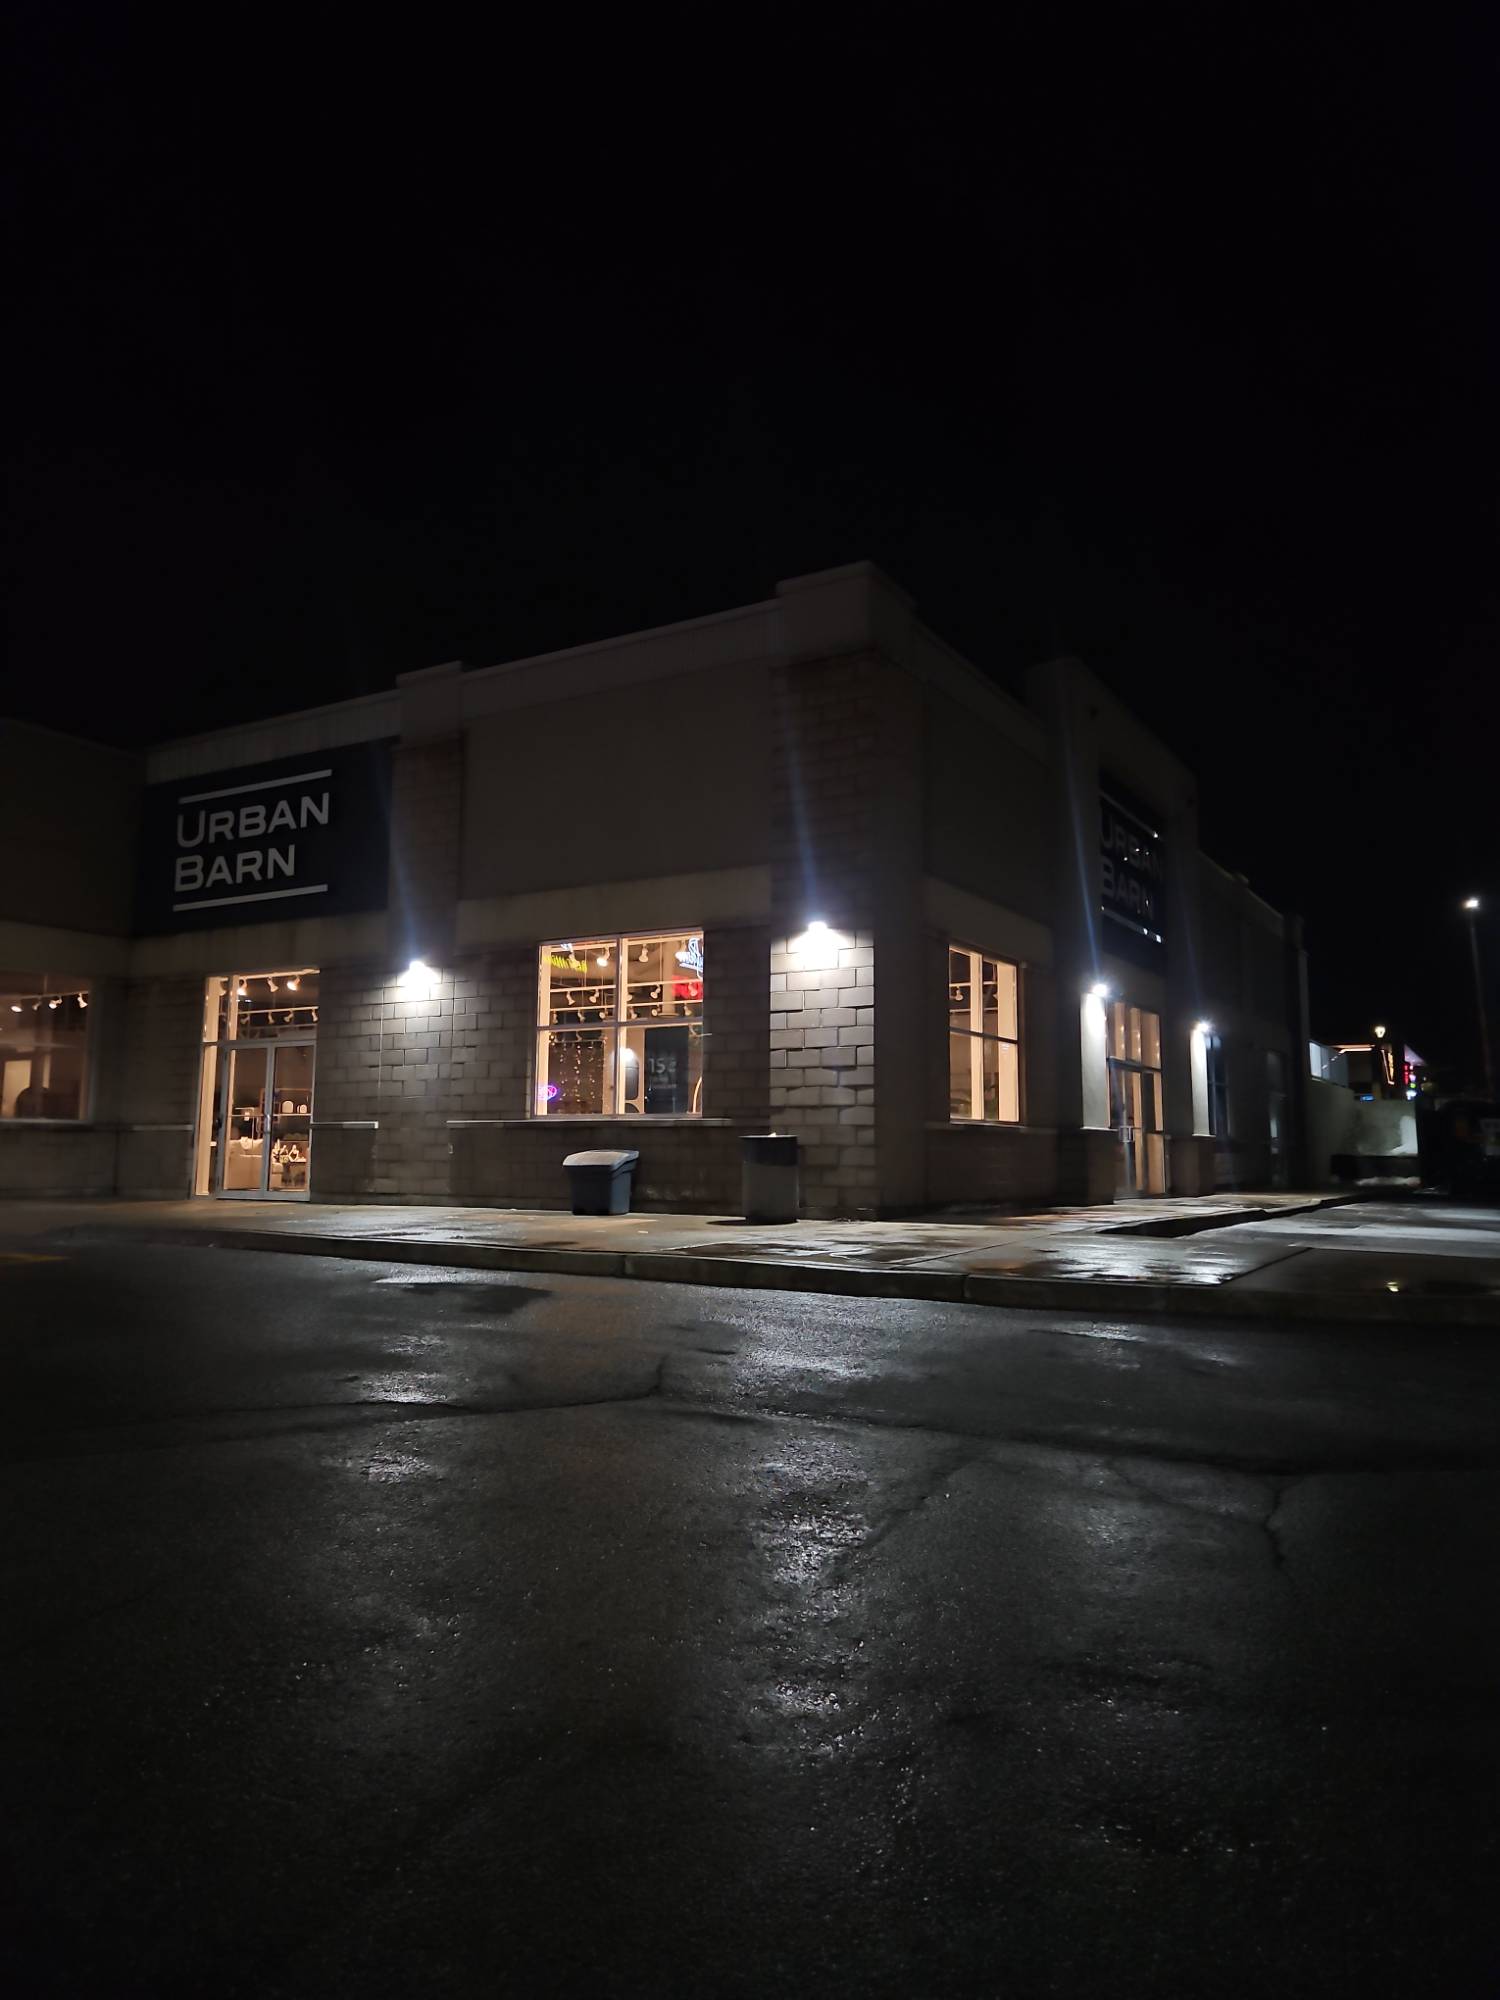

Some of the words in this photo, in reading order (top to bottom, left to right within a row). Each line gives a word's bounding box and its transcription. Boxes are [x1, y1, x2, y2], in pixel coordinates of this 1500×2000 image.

[176, 792, 331, 849] URBAN
[1100, 815, 1163, 882] URBAN
[174, 844, 296, 894] BARN
[1101, 856, 1154, 921] BARN
